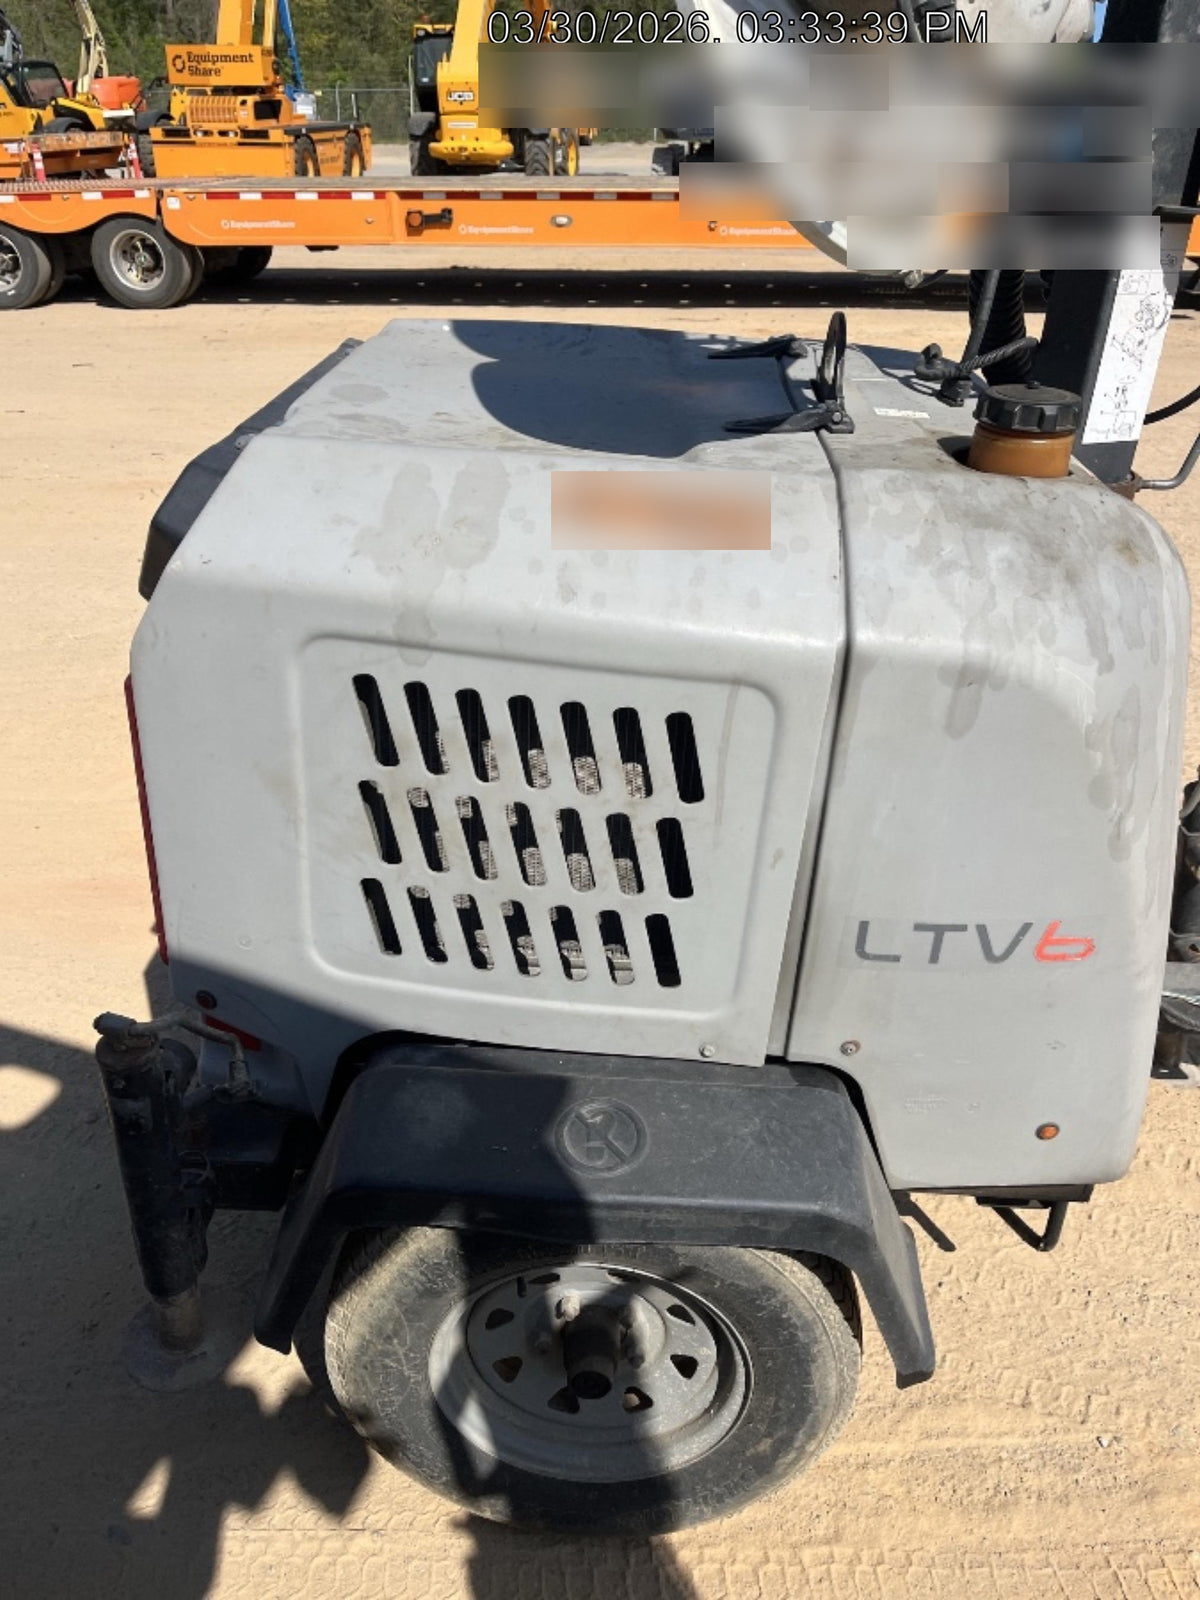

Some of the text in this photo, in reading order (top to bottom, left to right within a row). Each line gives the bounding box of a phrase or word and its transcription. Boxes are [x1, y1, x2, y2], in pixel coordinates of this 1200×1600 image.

[187, 51, 254, 65] Equipment
[188, 66, 221, 76] Share
[855, 920, 1096, 964] LTV6
